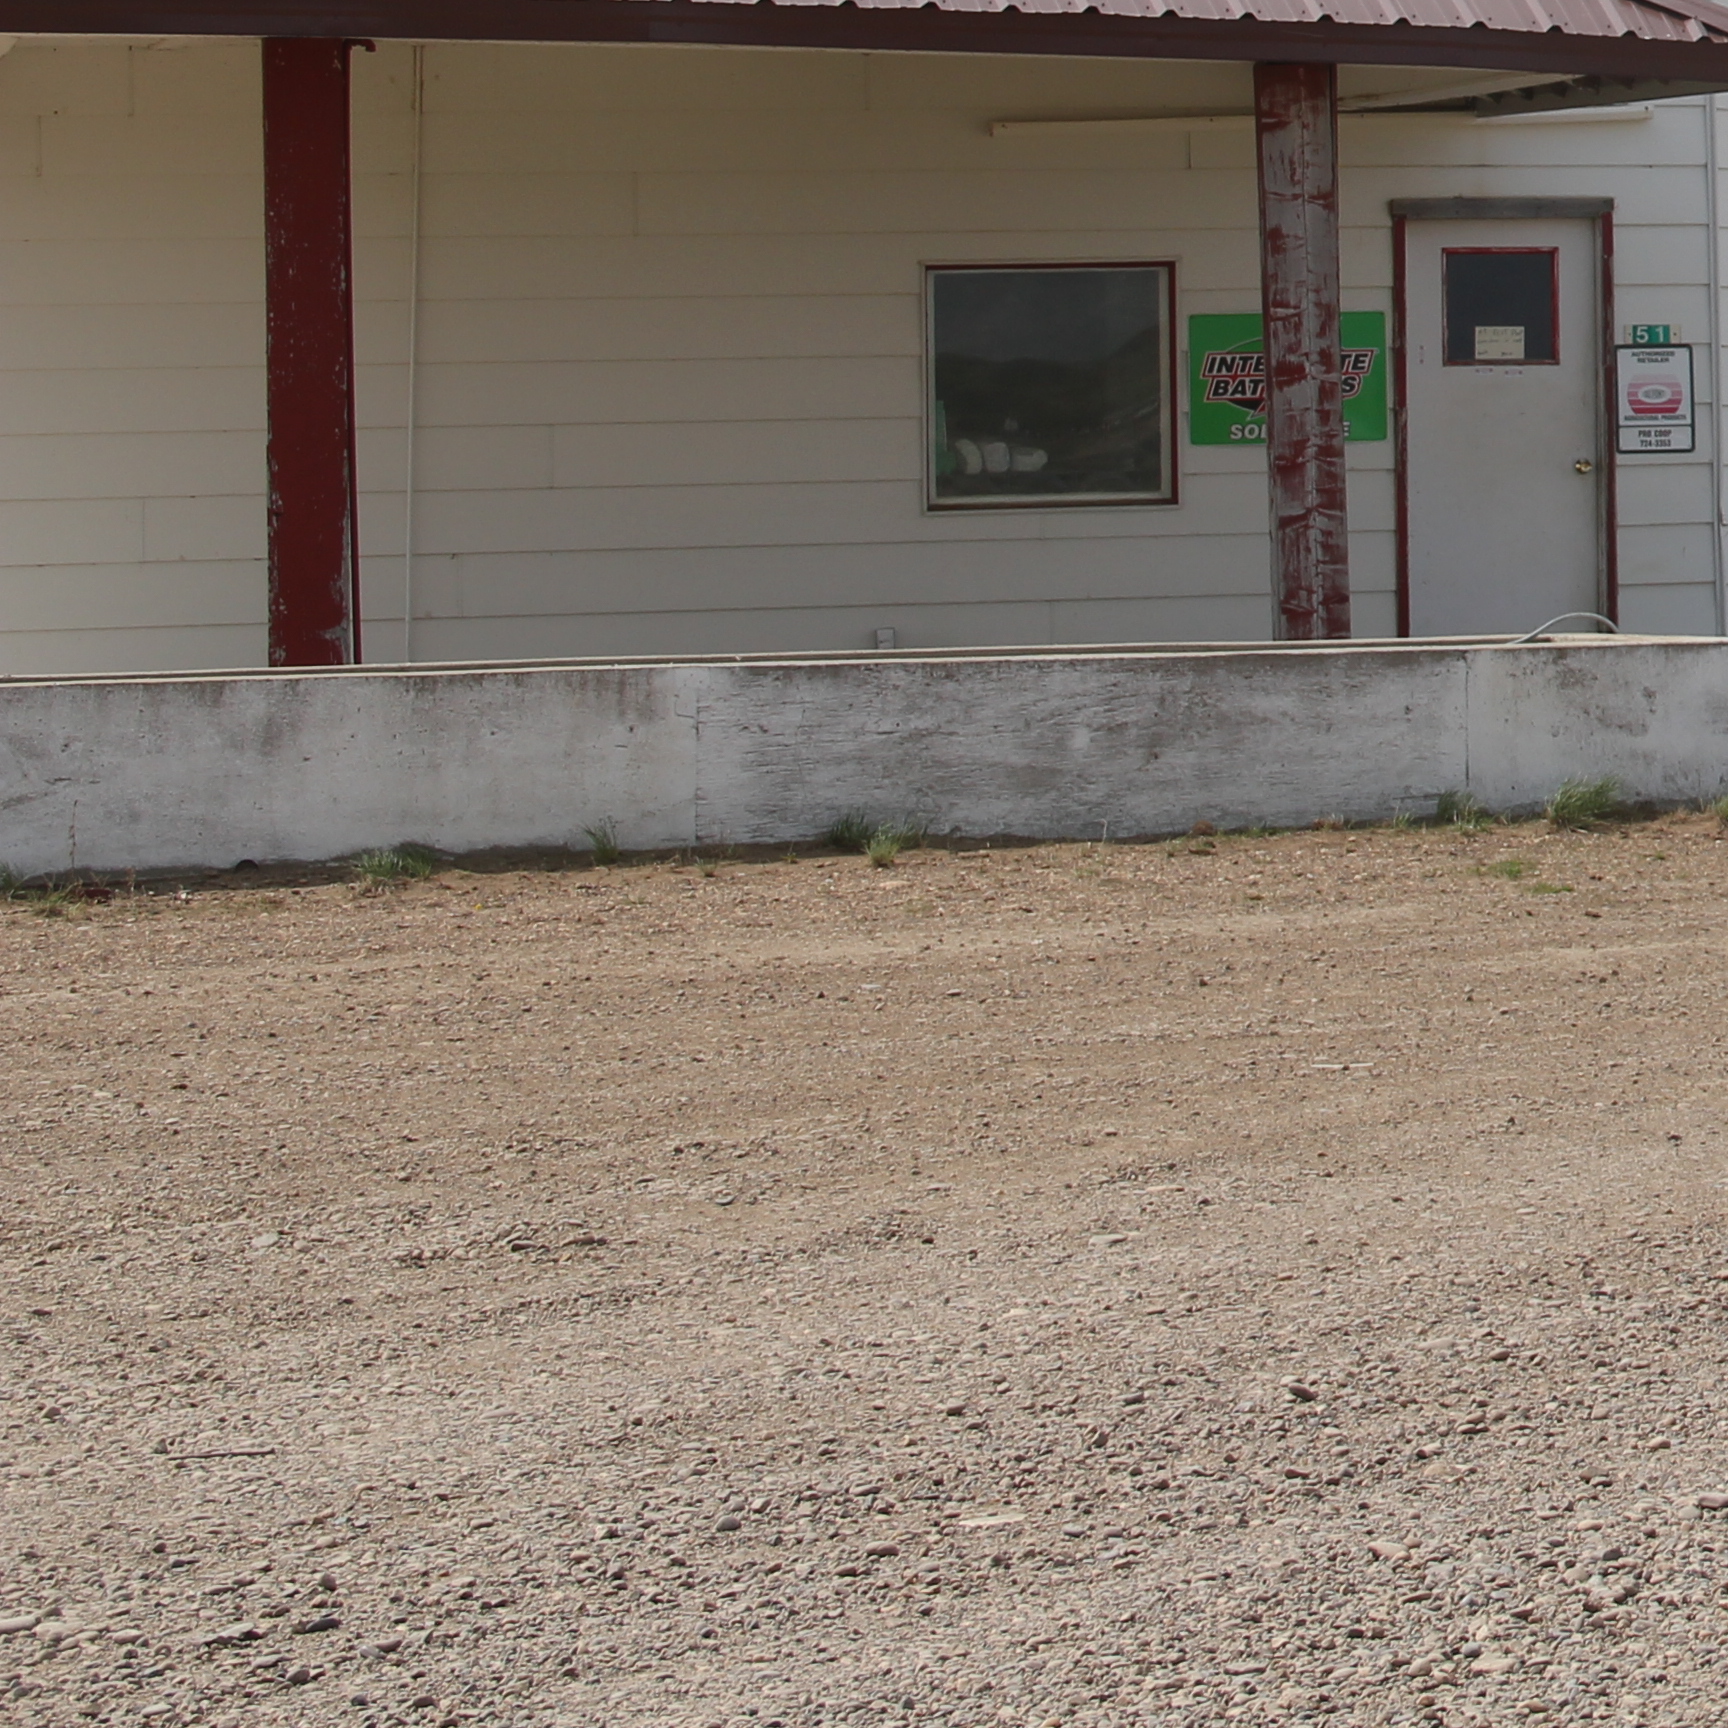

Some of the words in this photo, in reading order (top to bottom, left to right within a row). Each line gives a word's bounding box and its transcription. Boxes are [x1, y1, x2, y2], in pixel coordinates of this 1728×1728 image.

[1636, 326, 1664, 343] 51
[1638, 429, 1652, 438] PRO
[1654, 429, 1673, 438] COOP
